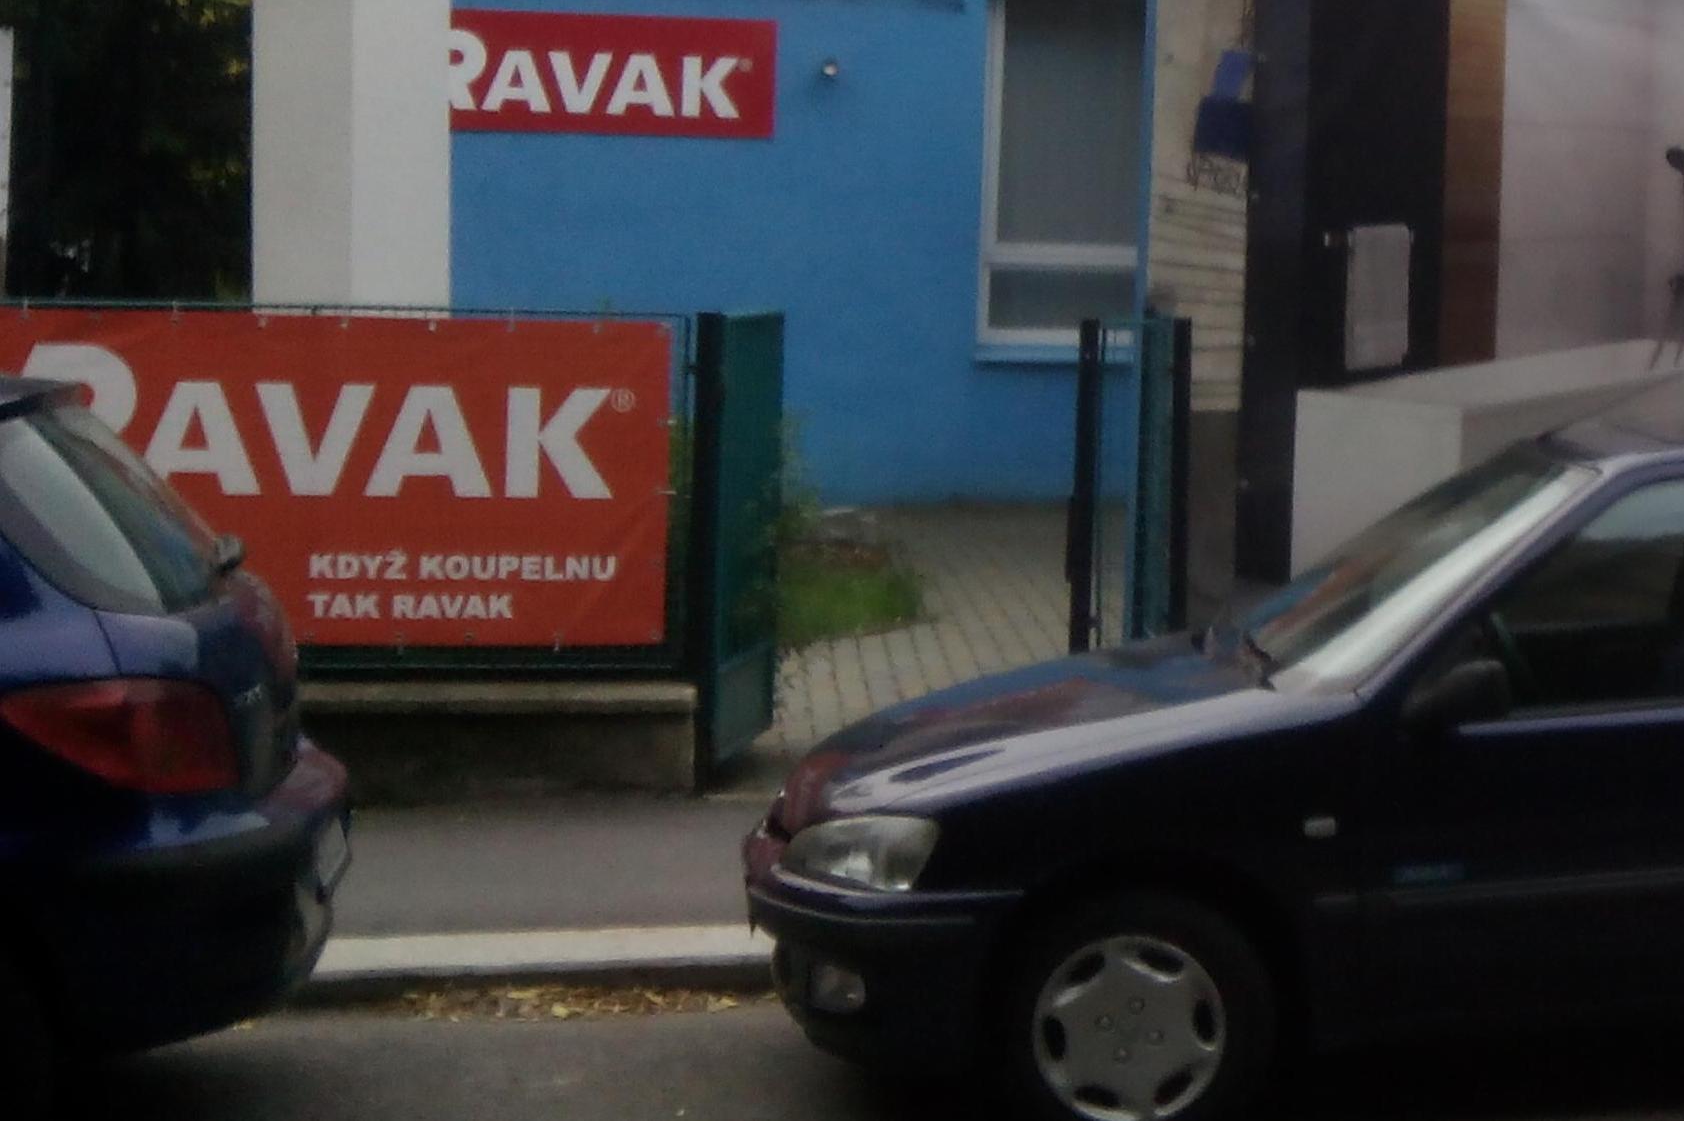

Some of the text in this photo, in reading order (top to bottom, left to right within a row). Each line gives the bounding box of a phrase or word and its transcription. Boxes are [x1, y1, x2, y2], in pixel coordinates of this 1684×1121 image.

[308, 549, 617, 581] KDYŽ KOUPELNU
[307, 590, 513, 620] TAK RAVAK
